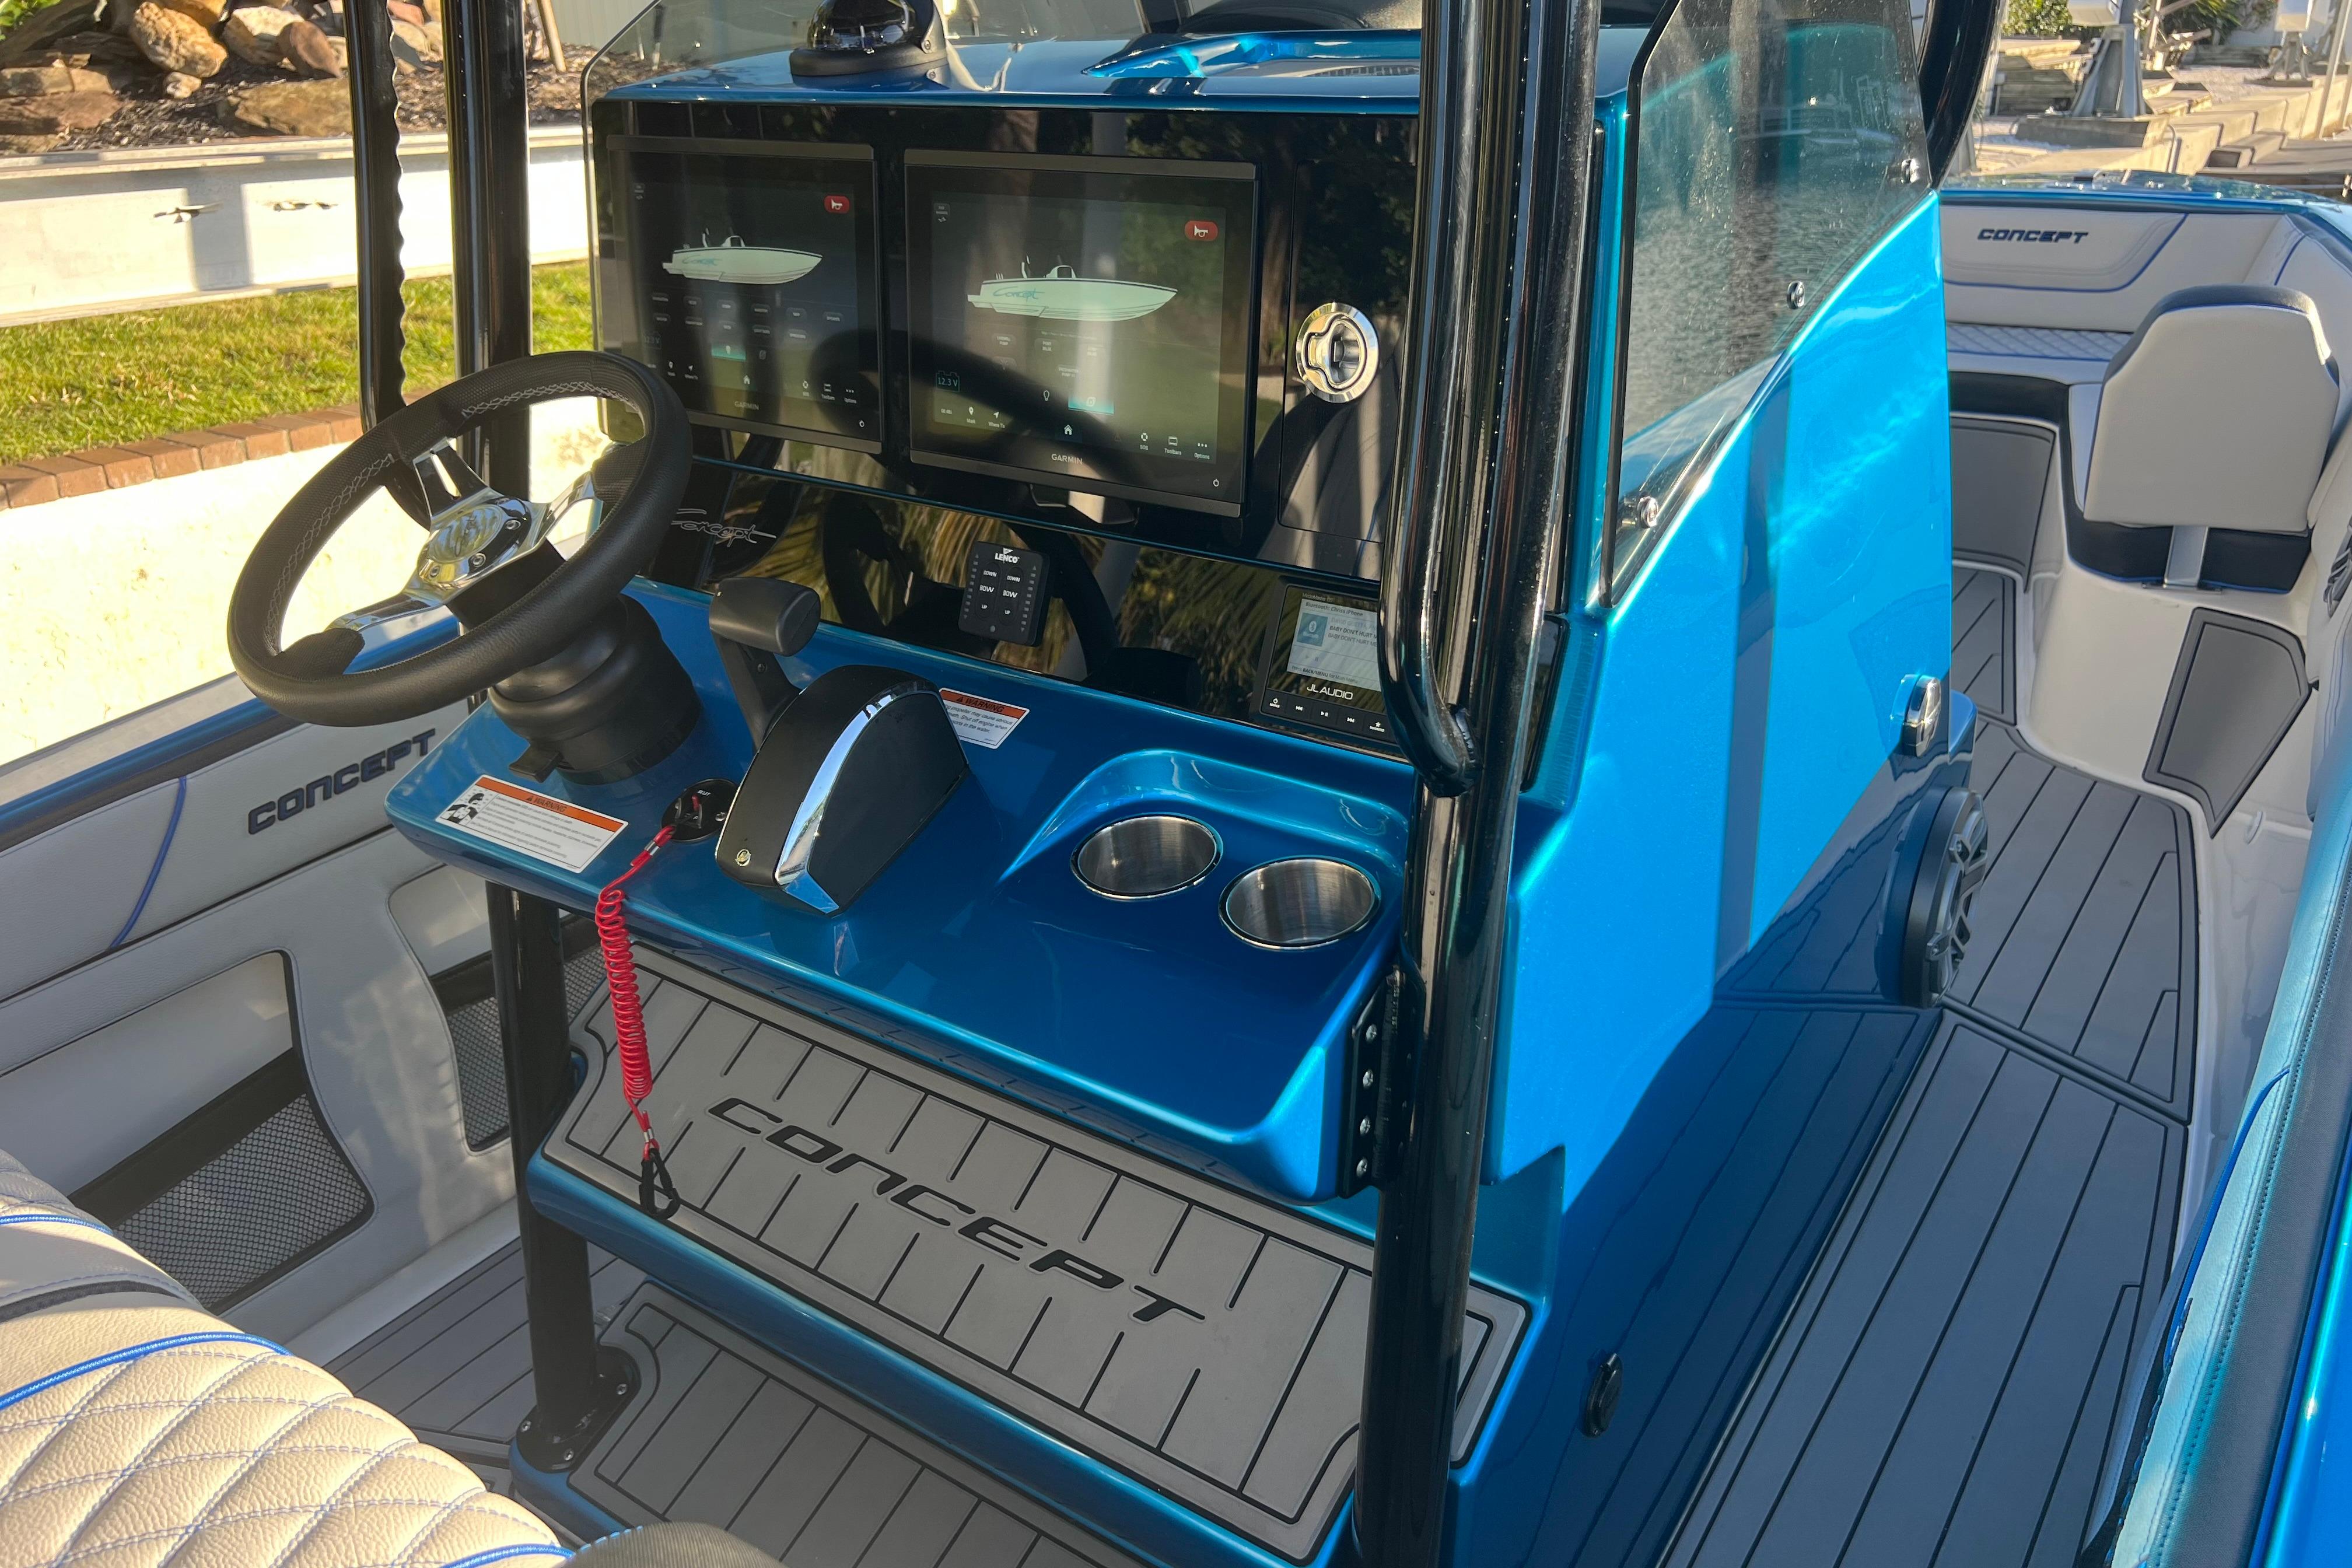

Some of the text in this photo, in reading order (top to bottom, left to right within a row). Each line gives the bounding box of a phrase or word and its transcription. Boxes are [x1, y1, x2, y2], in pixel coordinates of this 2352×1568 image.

[1978, 228, 2089, 244] CONCEPT
[937, 377, 958, 387] 12.3 V
[1051, 453, 1083, 465] GARMIN
[995, 553, 1019, 564] LENCO
[979, 584, 995, 593] BOW
[1003, 590, 1018, 598] BOW
[1306, 684, 1354, 700] JL AUDIO
[965, 698, 1005, 713] WARNING
[248, 728, 436, 835] CONCEPT
[708, 1097, 1206, 1322] CONCEPT
